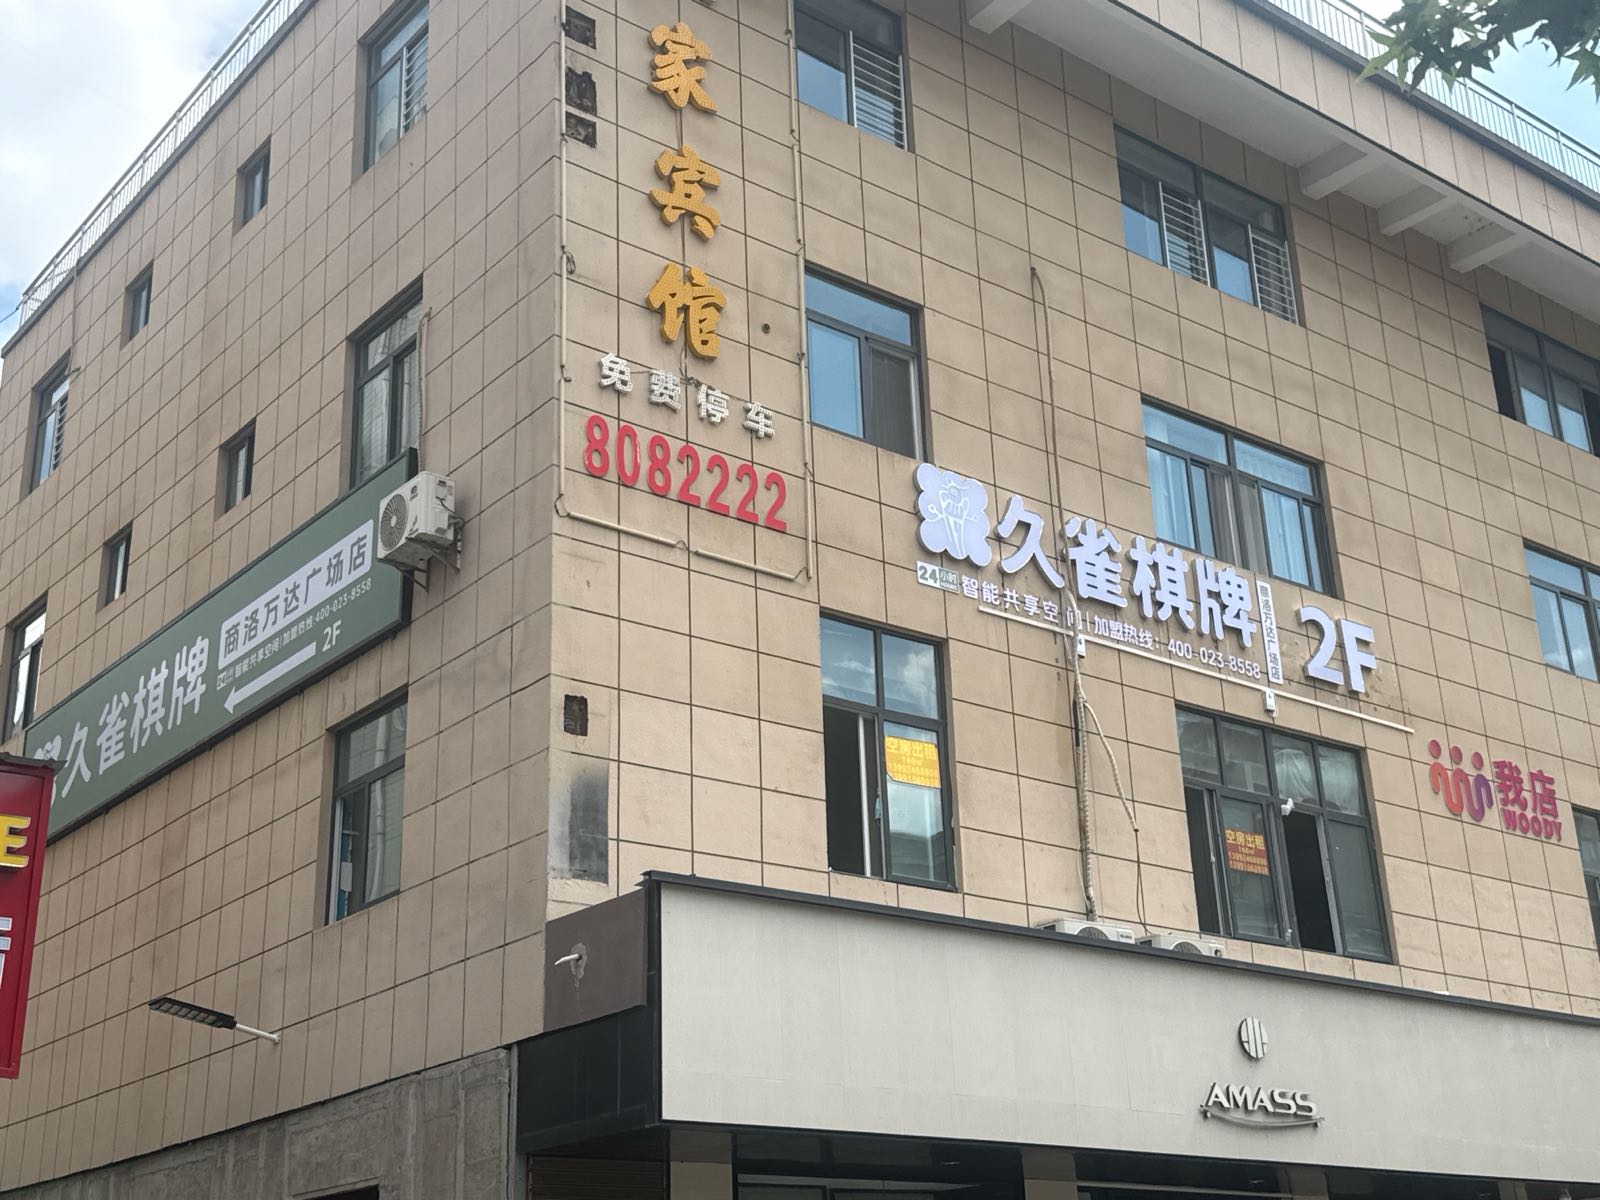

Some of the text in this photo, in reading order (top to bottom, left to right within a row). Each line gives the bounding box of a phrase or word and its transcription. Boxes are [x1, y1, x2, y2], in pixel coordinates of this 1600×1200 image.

[648, 21, 727, 360] 家宾馆
[600, 353, 776, 440] 免费停车
[585, 414, 788, 532] 8082222
[224, 533, 368, 659] 商洛万达广场店
[315, 577, 372, 622] 400-023-8558
[918, 565, 938, 584] 24
[997, 494, 1257, 649] 久雀棋牌
[322, 619, 342, 652] 2F
[1168, 638, 1262, 680] 400-023-8558
[1258, 585, 1281, 680] 商洛万达广场店
[1297, 605, 1378, 694] 2F
[61, 636, 210, 799] 久雀棋牌
[1493, 760, 1559, 819] 我店
[1501, 808, 1562, 842] WOODY
[1207, 1082, 1318, 1117] AMASS
